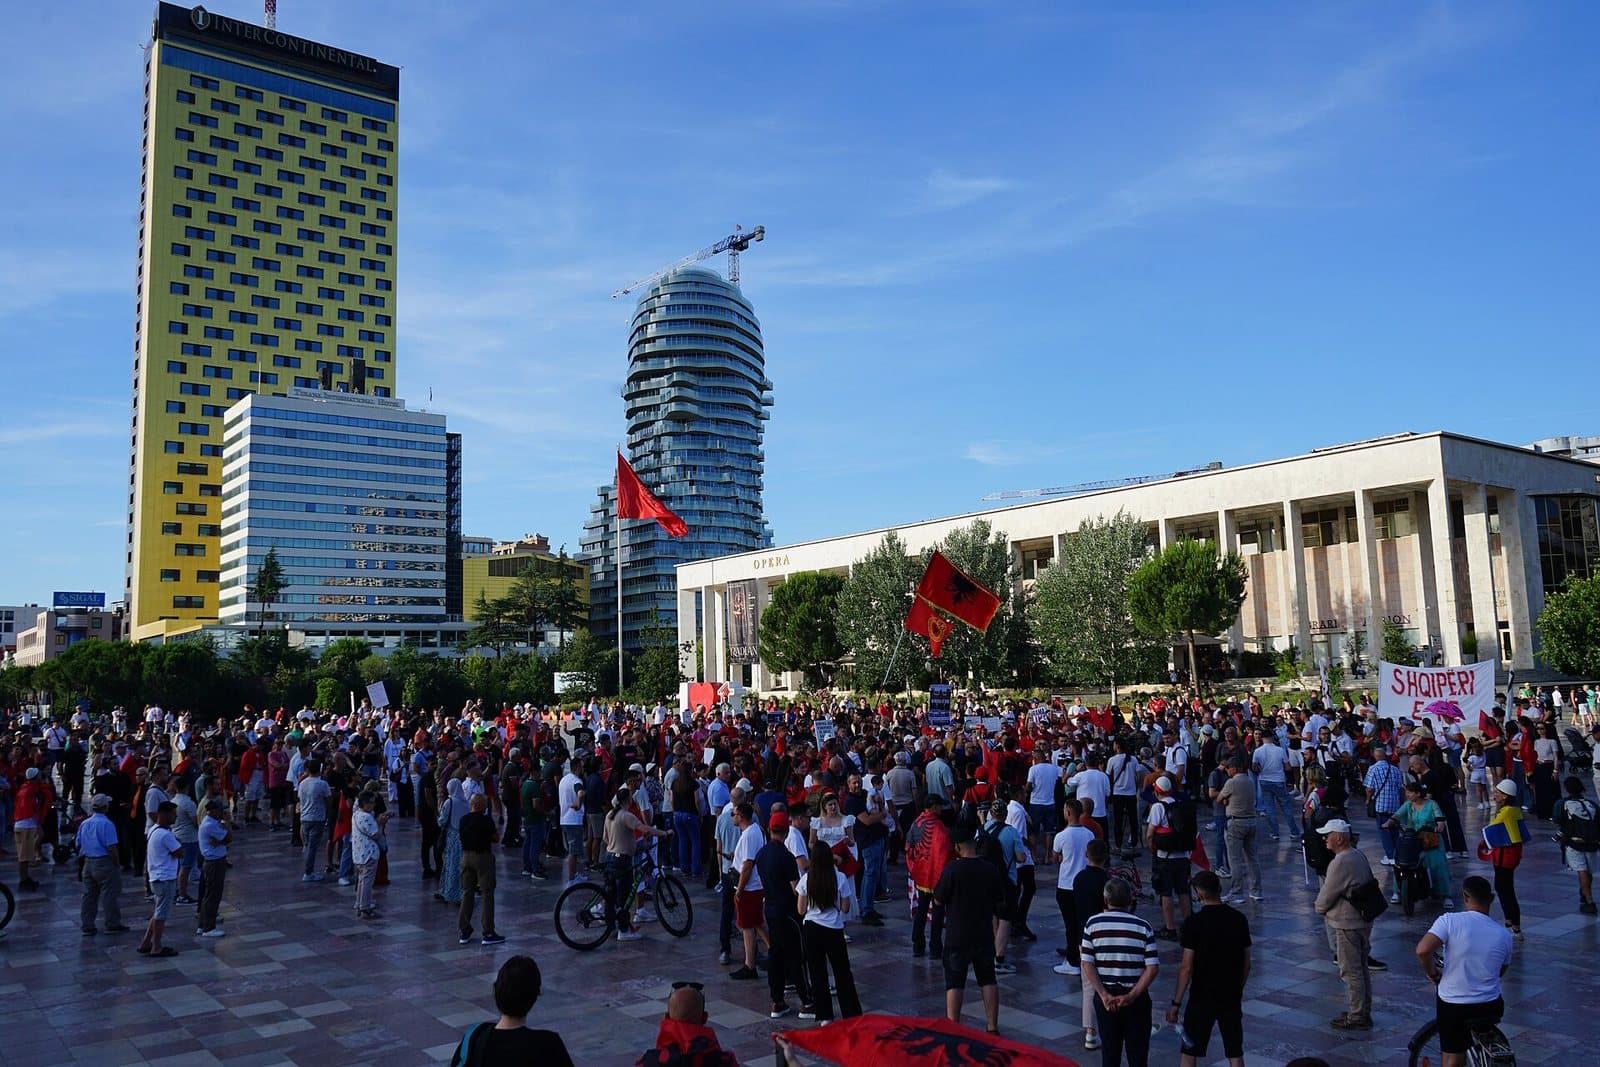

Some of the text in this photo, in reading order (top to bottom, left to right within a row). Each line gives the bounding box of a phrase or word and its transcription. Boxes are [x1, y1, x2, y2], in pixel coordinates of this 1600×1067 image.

[214, 16, 375, 72] INTERCONTINENTAL
[753, 554, 790, 569] OPERA
[69, 593, 100, 602] SIGAL
[1391, 668, 1475, 698] SHQIPËRI
